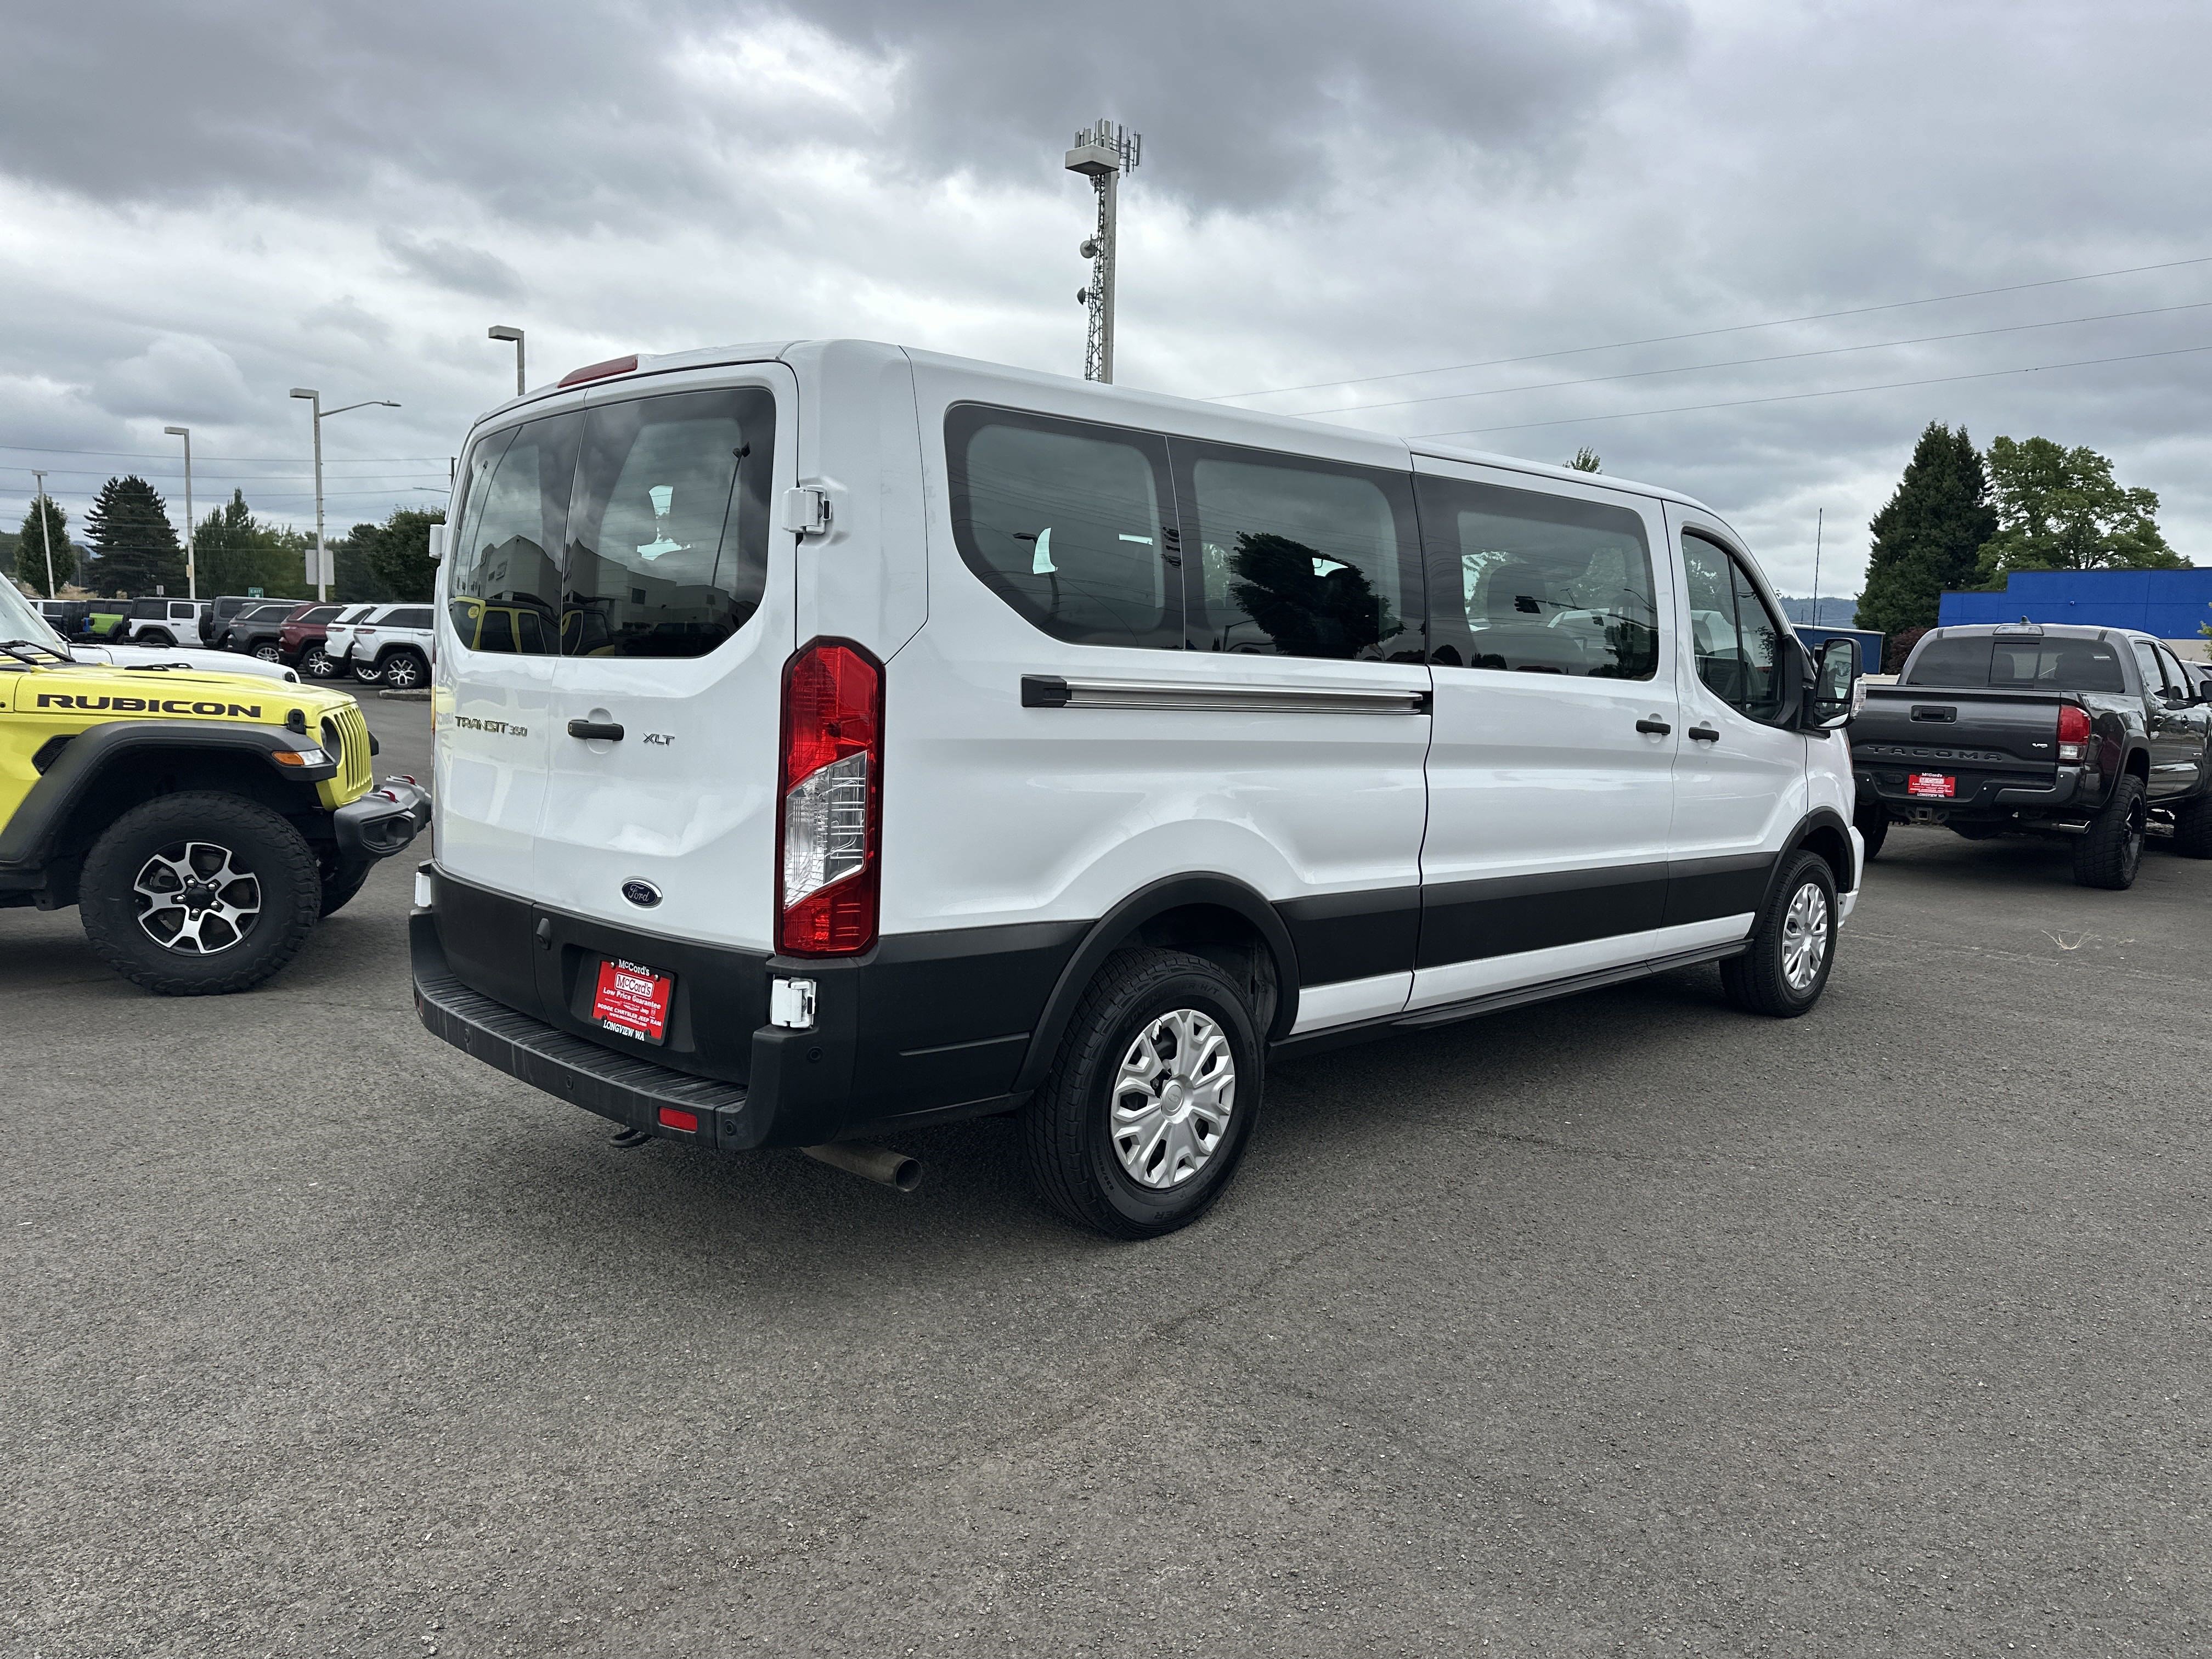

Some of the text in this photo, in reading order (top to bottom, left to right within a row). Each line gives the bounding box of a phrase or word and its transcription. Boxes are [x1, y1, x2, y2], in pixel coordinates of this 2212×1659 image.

[36, 693, 261, 718] RUBICON
[455, 716, 528, 737] TRANSIT 350
[642, 732, 675, 747] XLT
[1866, 746, 2002, 761] TACOMA
[628, 884, 650, 902] Ford
[618, 959, 650, 976] McCord's
[617, 975, 651, 995] McCord's
[603, 987, 616, 996] Low
[616, 990, 631, 1000] Price
[631, 994, 662, 1009] Guarantee
[597, 1002, 614, 1012] DODGE
[614, 1007, 638, 1019] CHRYSLER
[650, 1018, 662, 1027] RAM
[602, 1019, 635, 1037] LONGVIEW
[634, 1030, 645, 1041] WA
